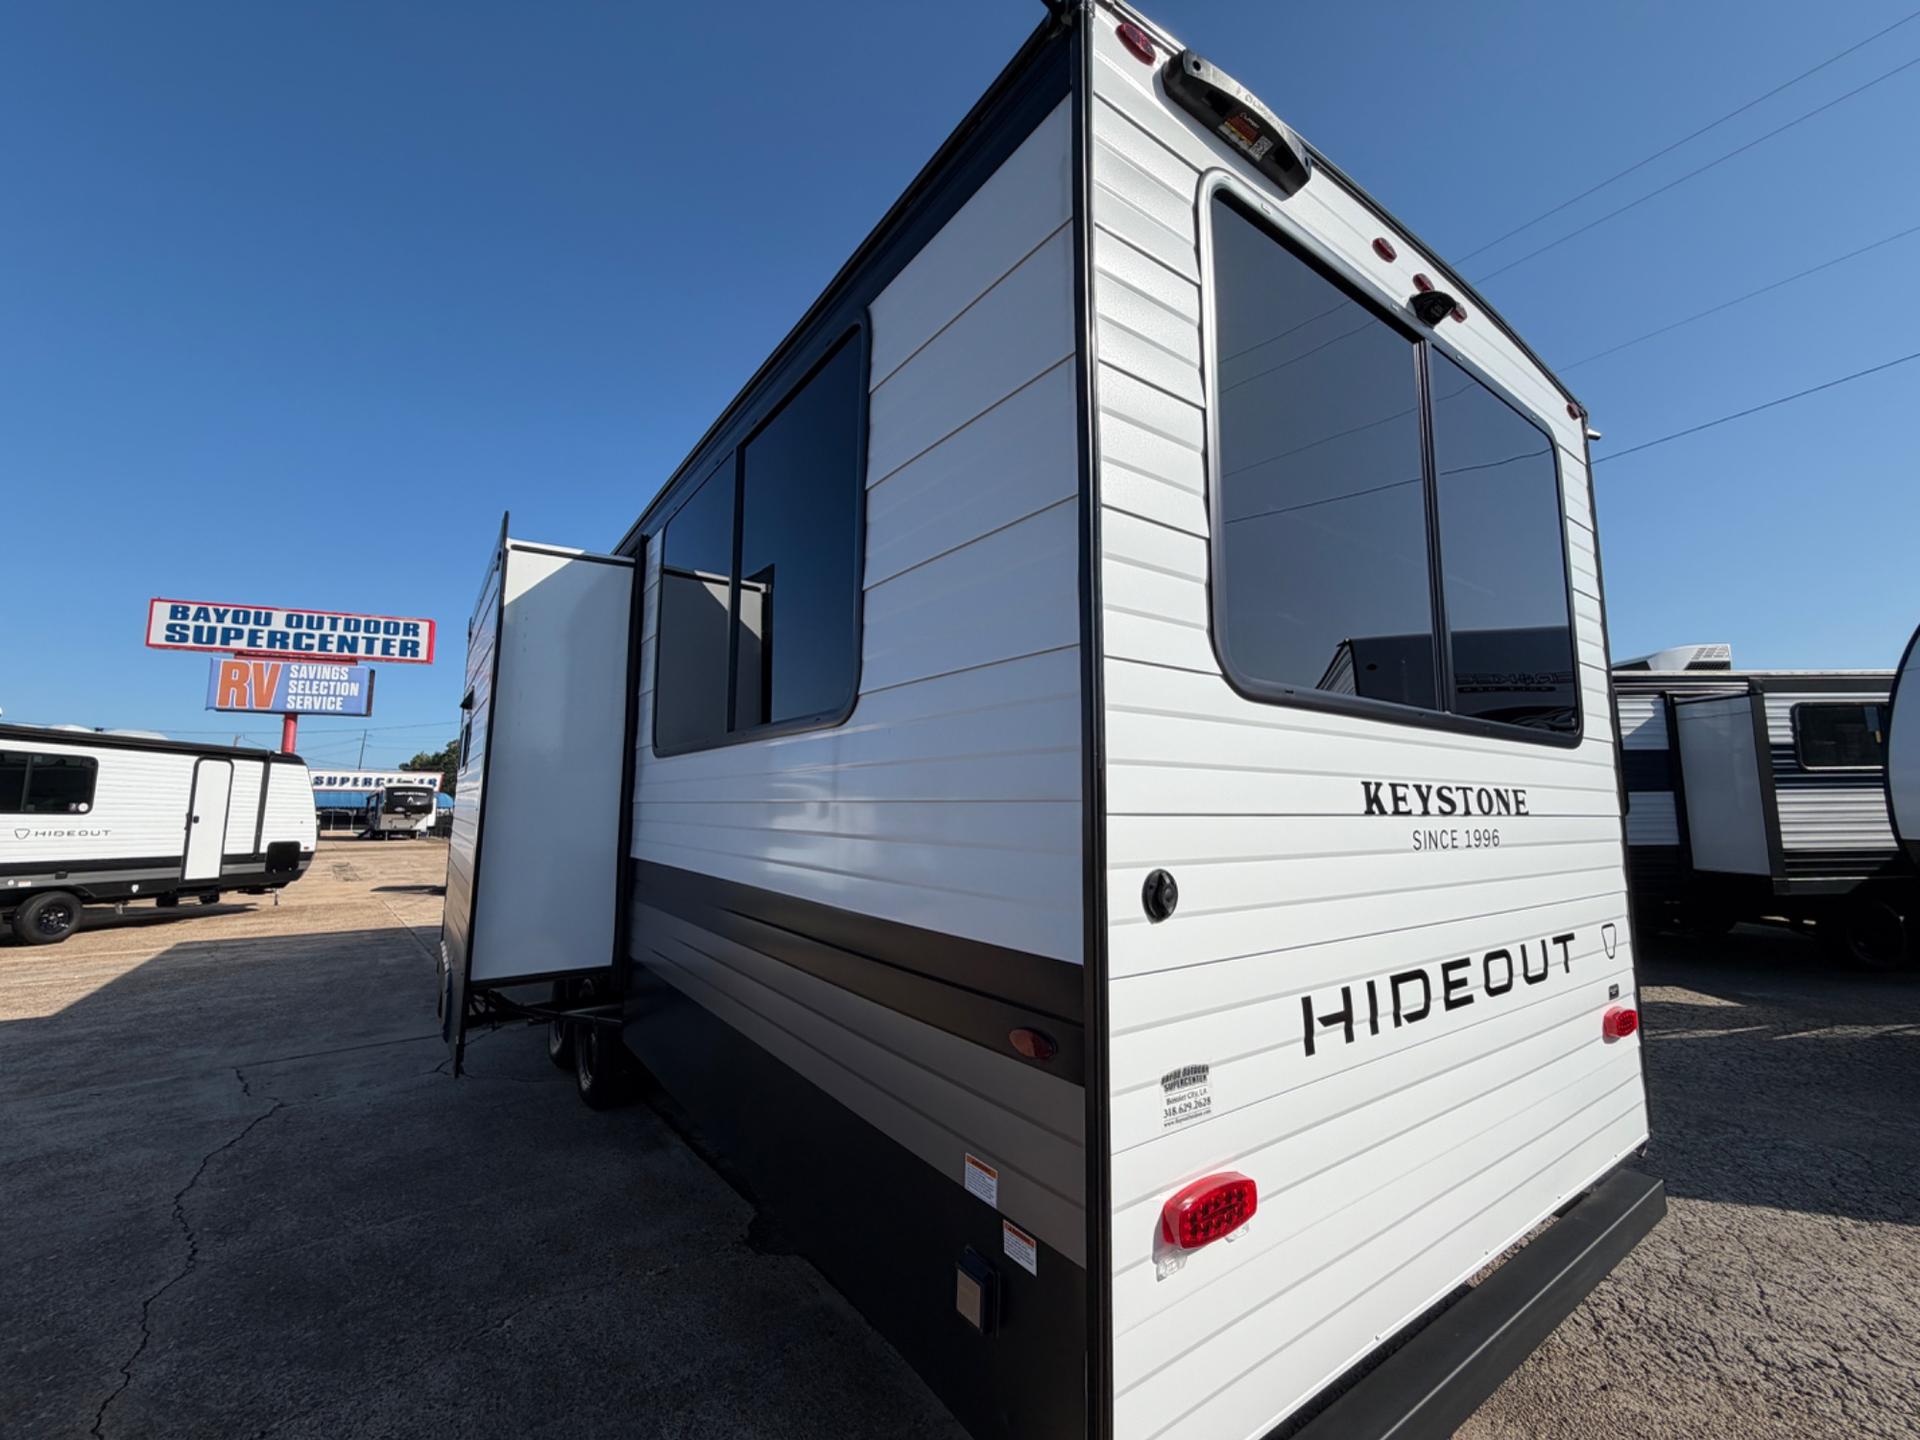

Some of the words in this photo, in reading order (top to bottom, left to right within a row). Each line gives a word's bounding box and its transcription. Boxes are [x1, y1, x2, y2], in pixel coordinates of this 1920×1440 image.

[169, 604, 273, 627] BAYOU
[285, 613, 420, 637] OUTDOOR
[165, 623, 420, 658] SUPERCENTER
[216, 660, 282, 709] RV
[290, 665, 349, 681] SAVINGS
[288, 680, 359, 697] SELECTION
[286, 695, 344, 711] SERVICE
[1361, 781, 1529, 817] KEYSTONE
[34, 829, 112, 837] HIDEOUT
[1412, 829, 1458, 851] SINCE
[1465, 828, 1500, 848] 1996
[1301, 932, 1575, 1057] HIDEOUT
